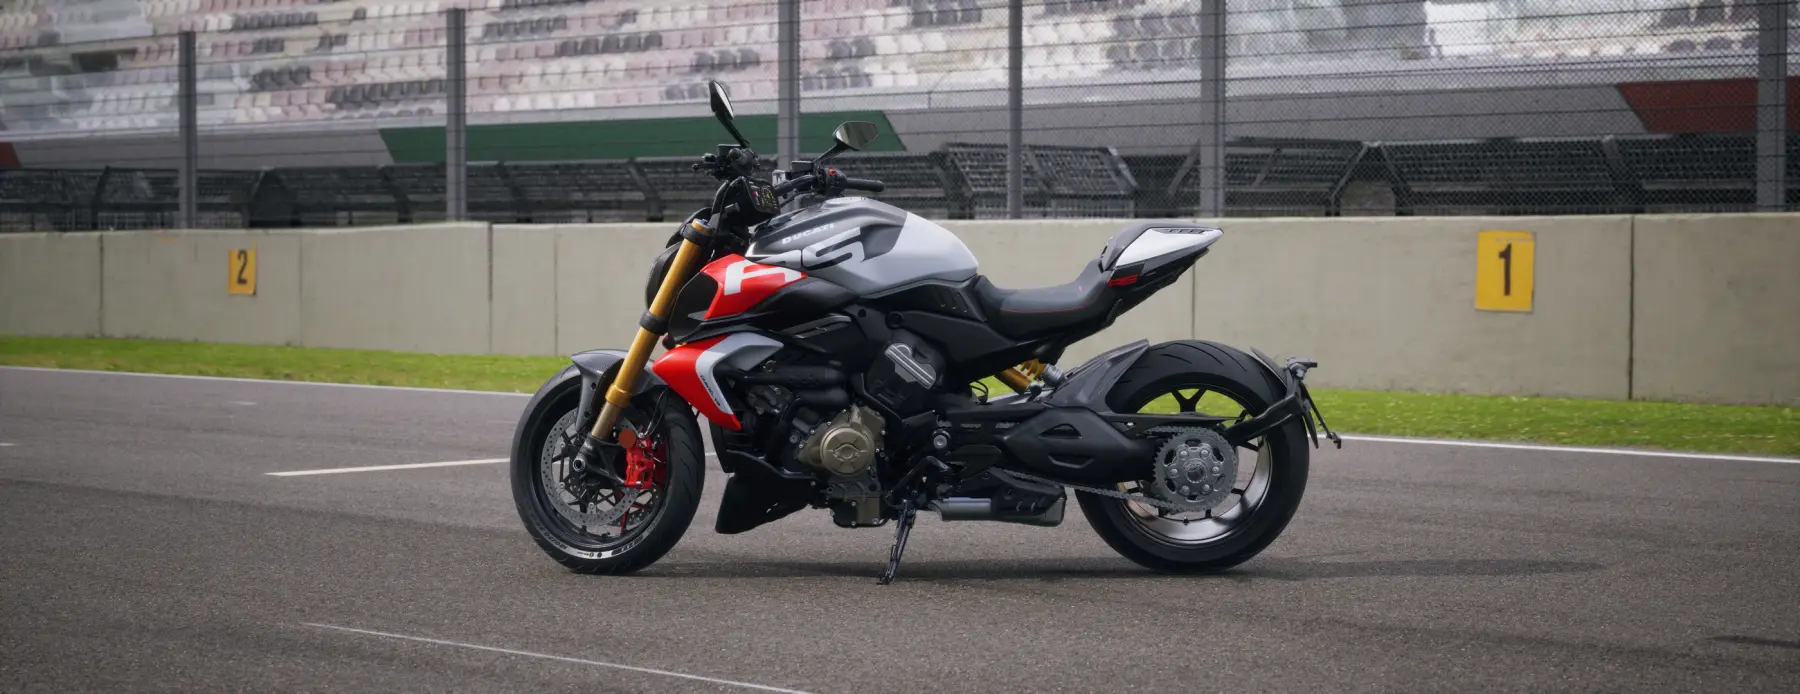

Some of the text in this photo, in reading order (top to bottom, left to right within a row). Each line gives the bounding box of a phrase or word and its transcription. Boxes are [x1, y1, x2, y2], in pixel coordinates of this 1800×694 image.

[782, 224, 834, 245] DUCATI
[237, 249, 248, 284] 2
[1498, 243, 1511, 296] 1
